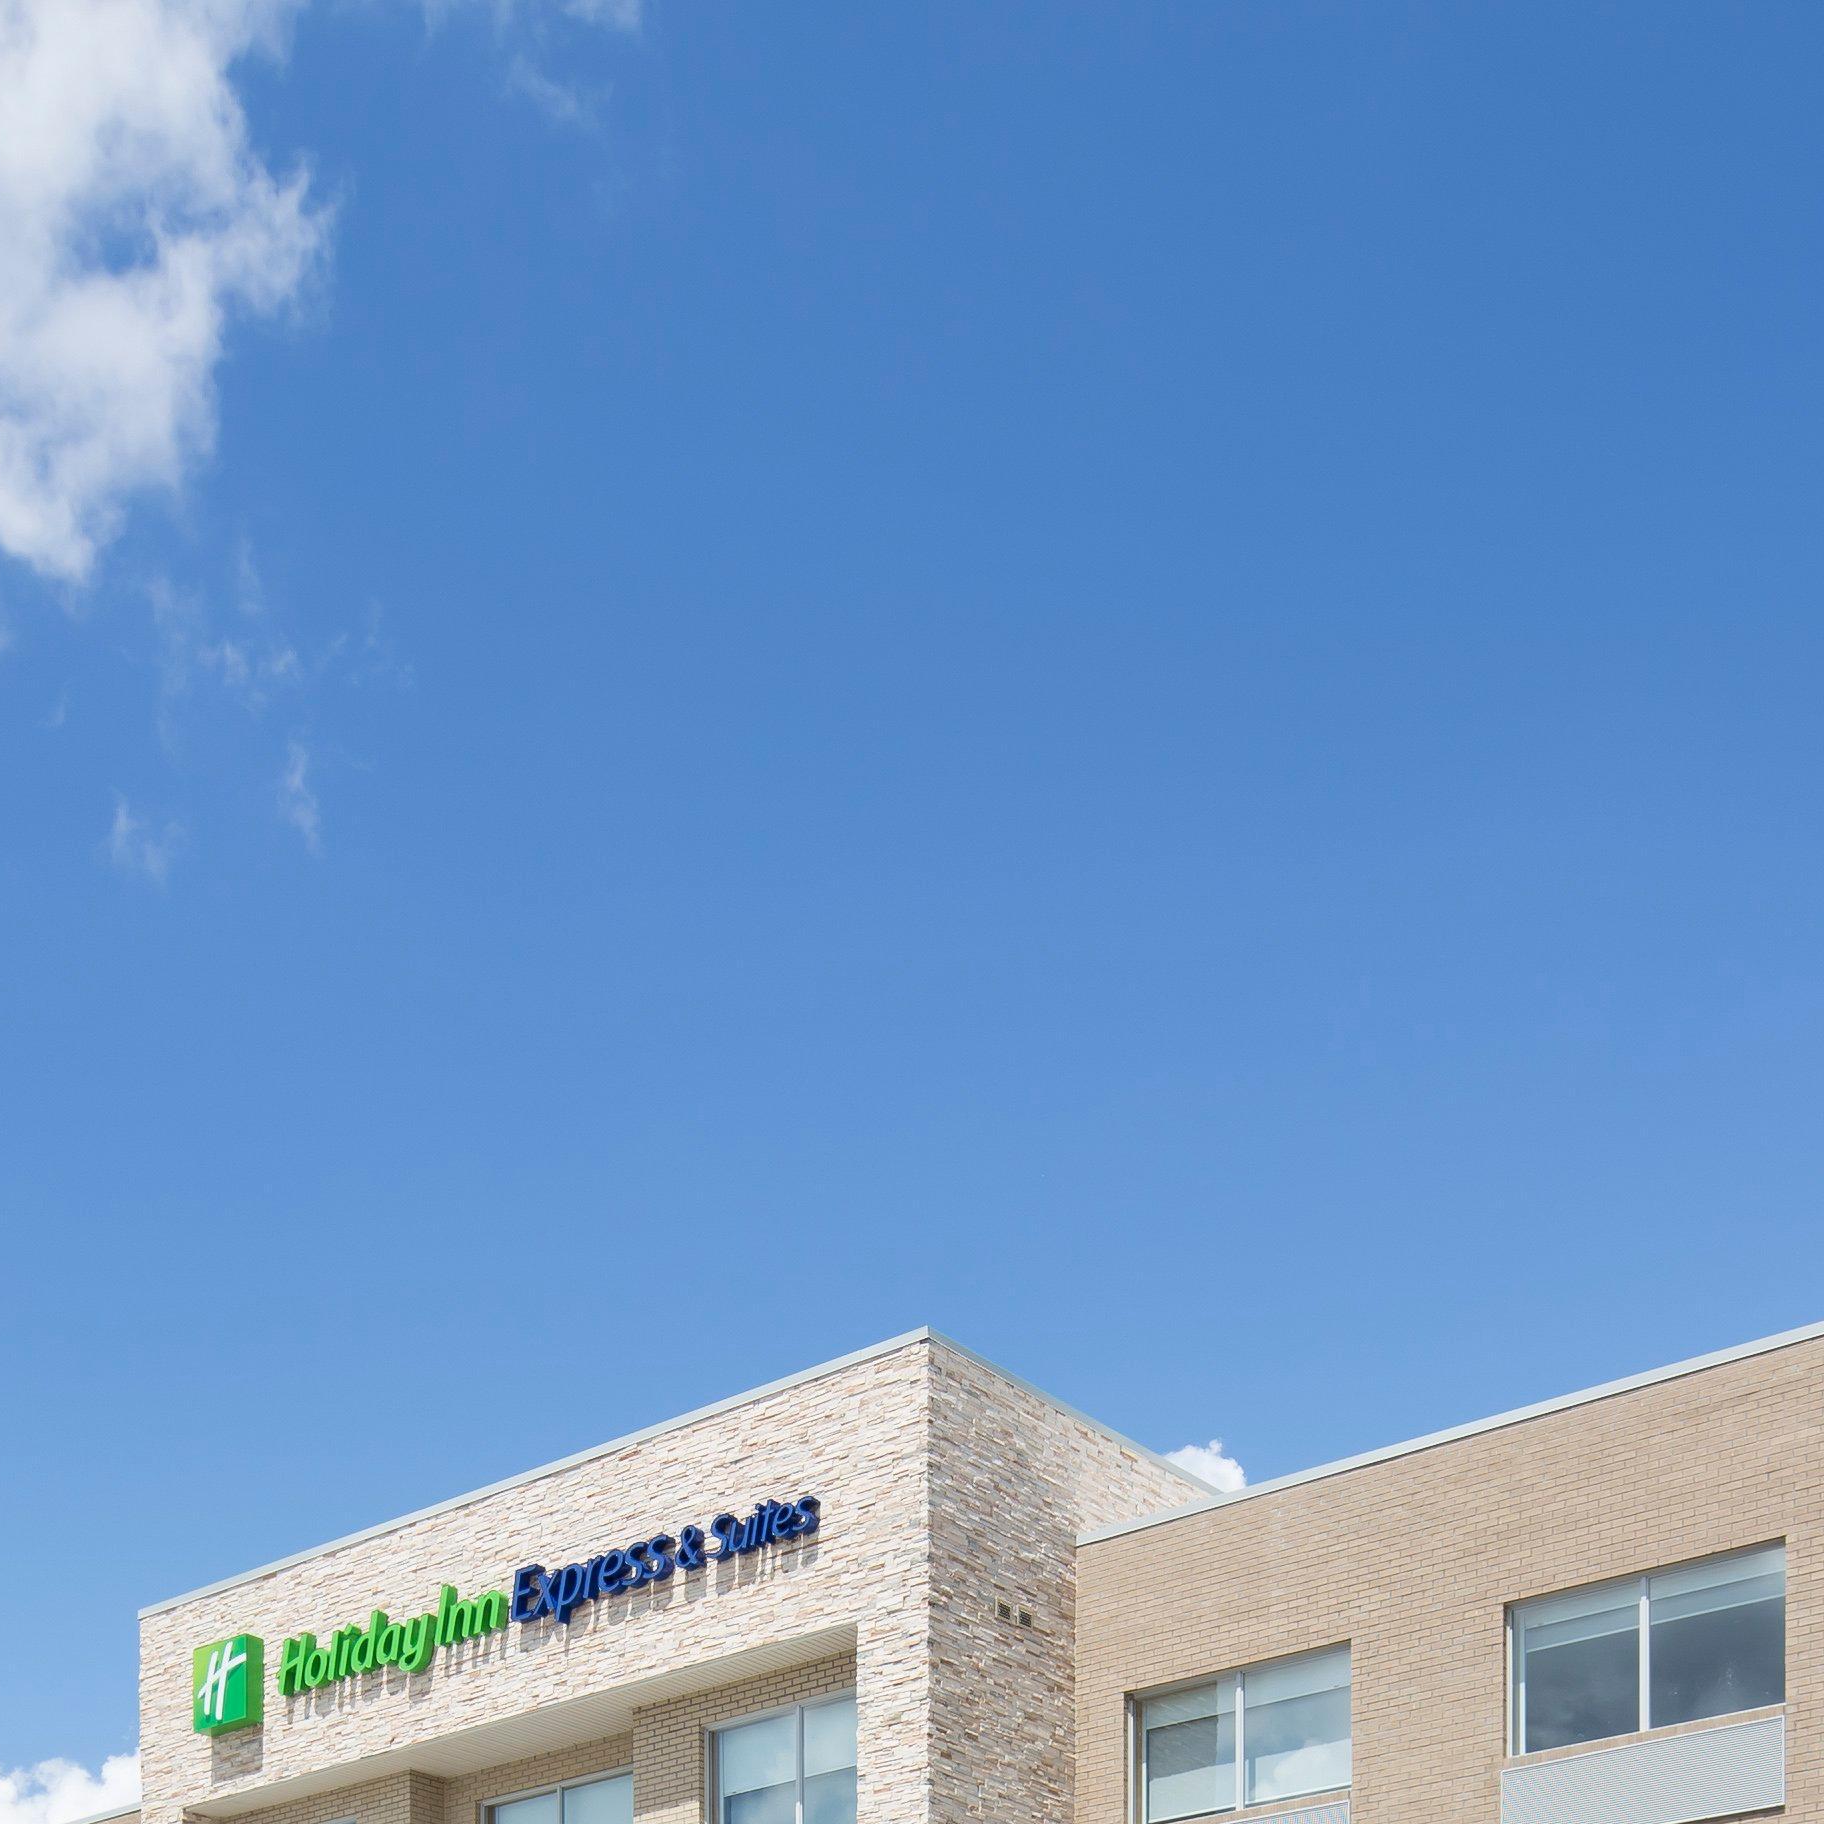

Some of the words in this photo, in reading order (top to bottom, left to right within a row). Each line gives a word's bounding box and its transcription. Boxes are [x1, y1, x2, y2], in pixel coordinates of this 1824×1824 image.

[278, 1609, 437, 1696] Holiday
[434, 1584, 509, 1646] Inn
[512, 1534, 675, 1624] Express
[676, 1525, 706, 1570] &
[706, 1495, 821, 1560] Suites
